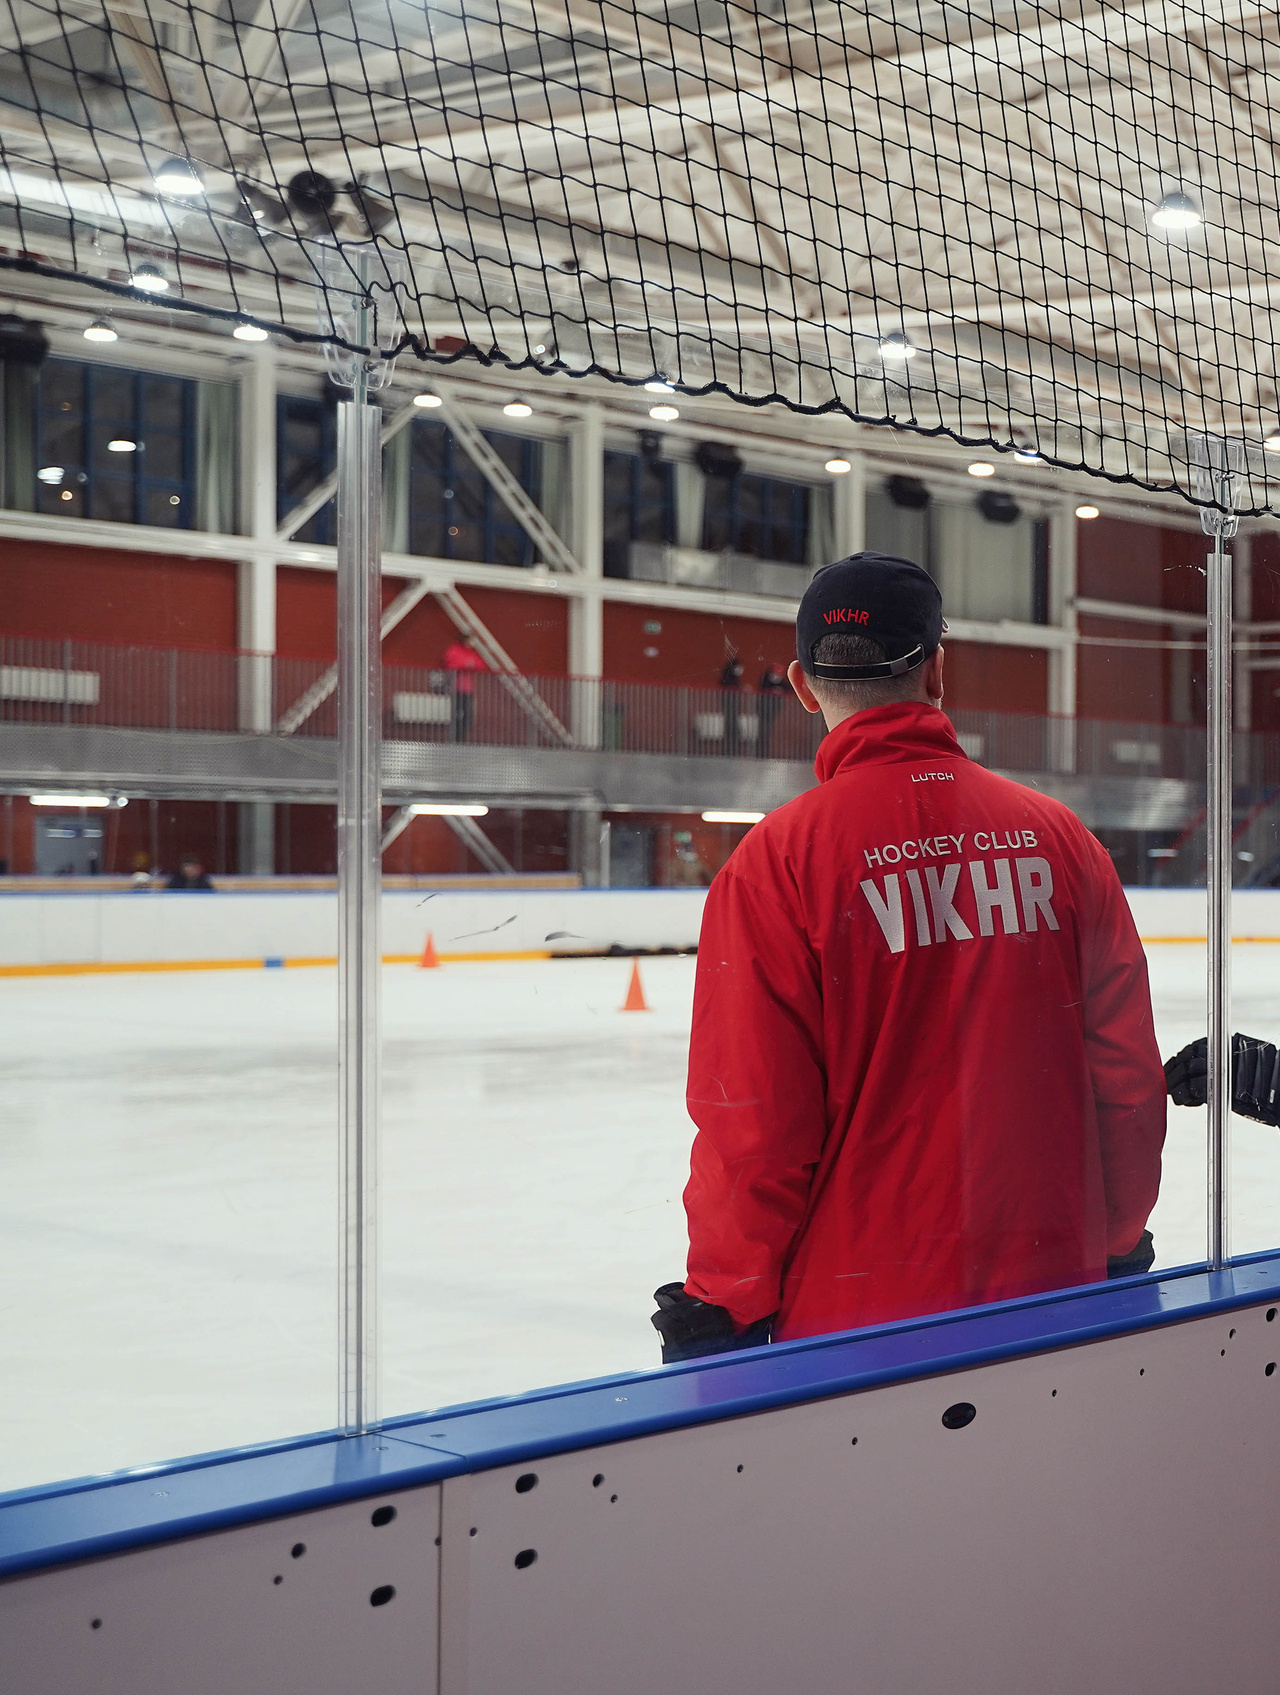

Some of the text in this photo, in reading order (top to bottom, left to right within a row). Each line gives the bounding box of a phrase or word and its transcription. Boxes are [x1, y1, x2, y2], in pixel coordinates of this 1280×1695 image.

[823, 608, 870, 626] VIKHR
[911, 772, 955, 783] LUTCH
[863, 830, 1038, 868] HOCKEY CLUB
[859, 856, 1060, 953] VIKHR
